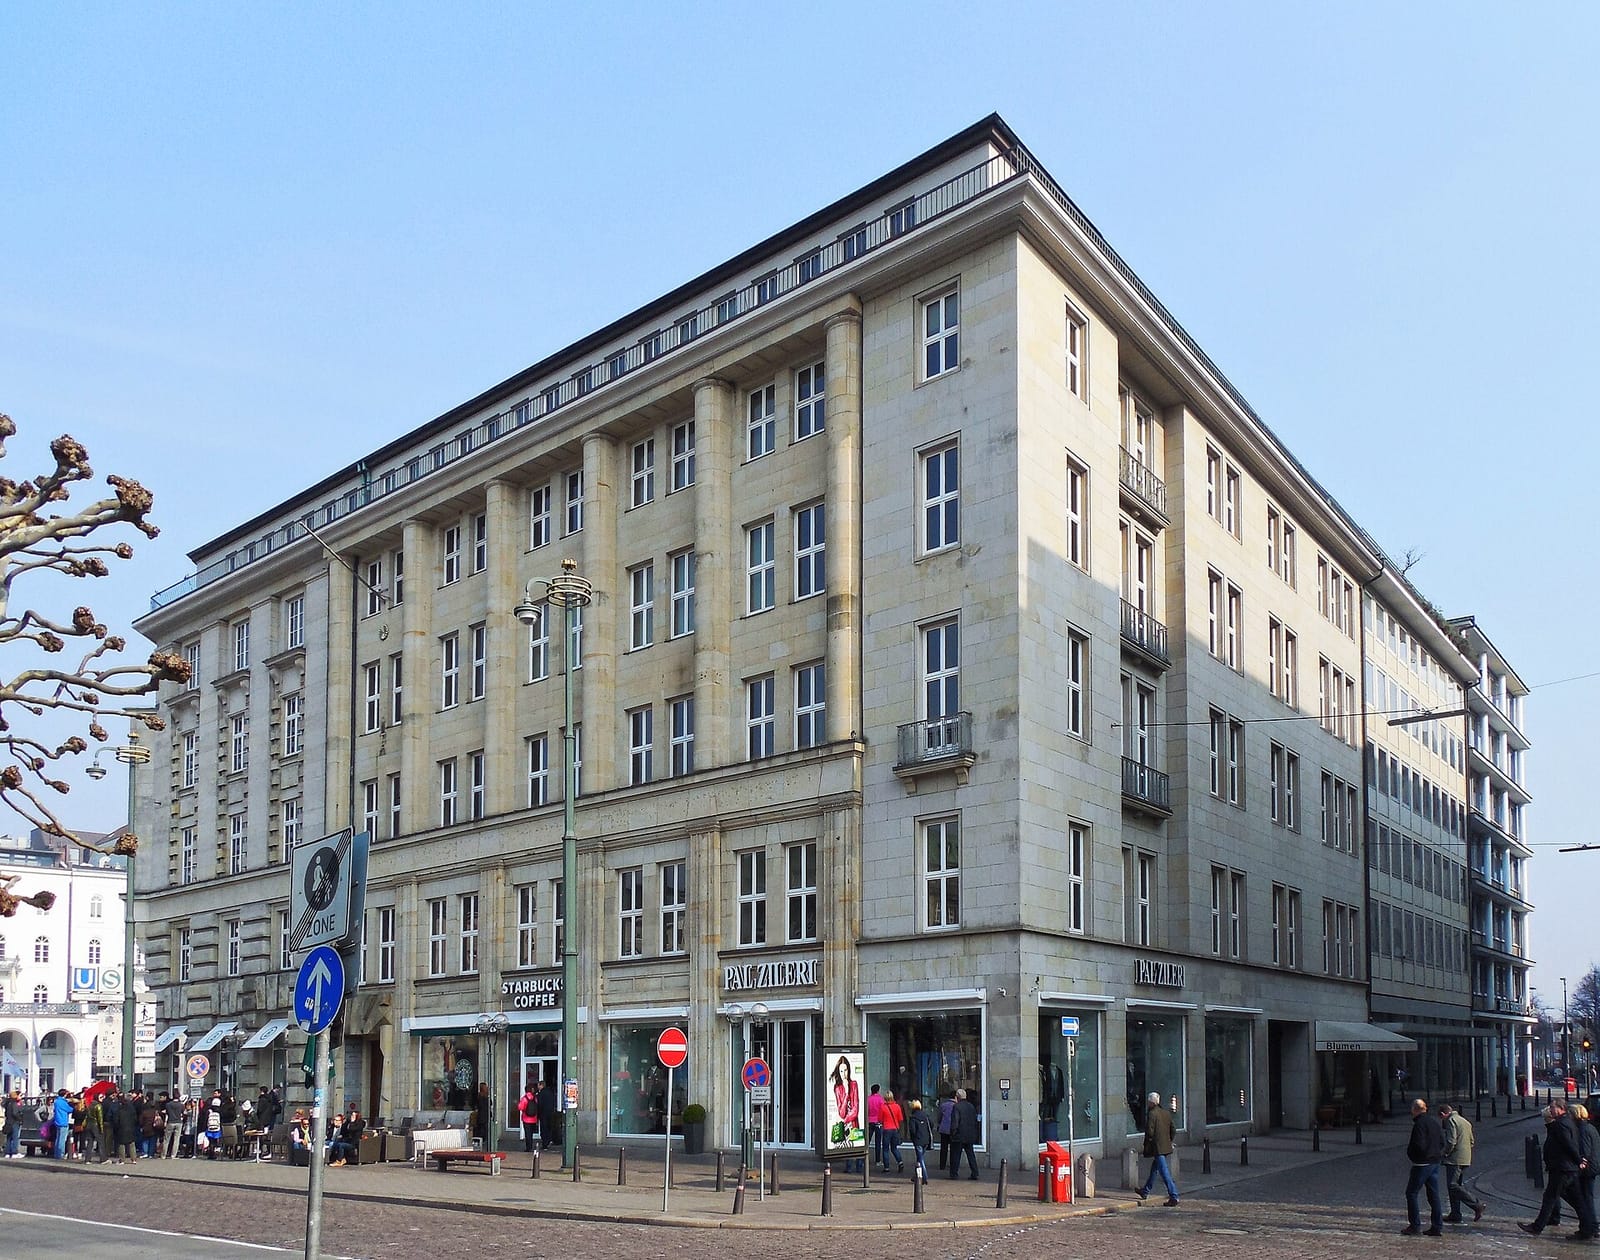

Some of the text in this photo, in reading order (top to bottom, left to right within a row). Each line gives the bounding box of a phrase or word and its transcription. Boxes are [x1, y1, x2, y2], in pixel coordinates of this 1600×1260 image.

[75, 968, 120, 989] U S
[724, 959, 818, 989] PAL ZILERI
[514, 993, 555, 1008] COFFEE
[1326, 1042, 1361, 1051] Blumen
